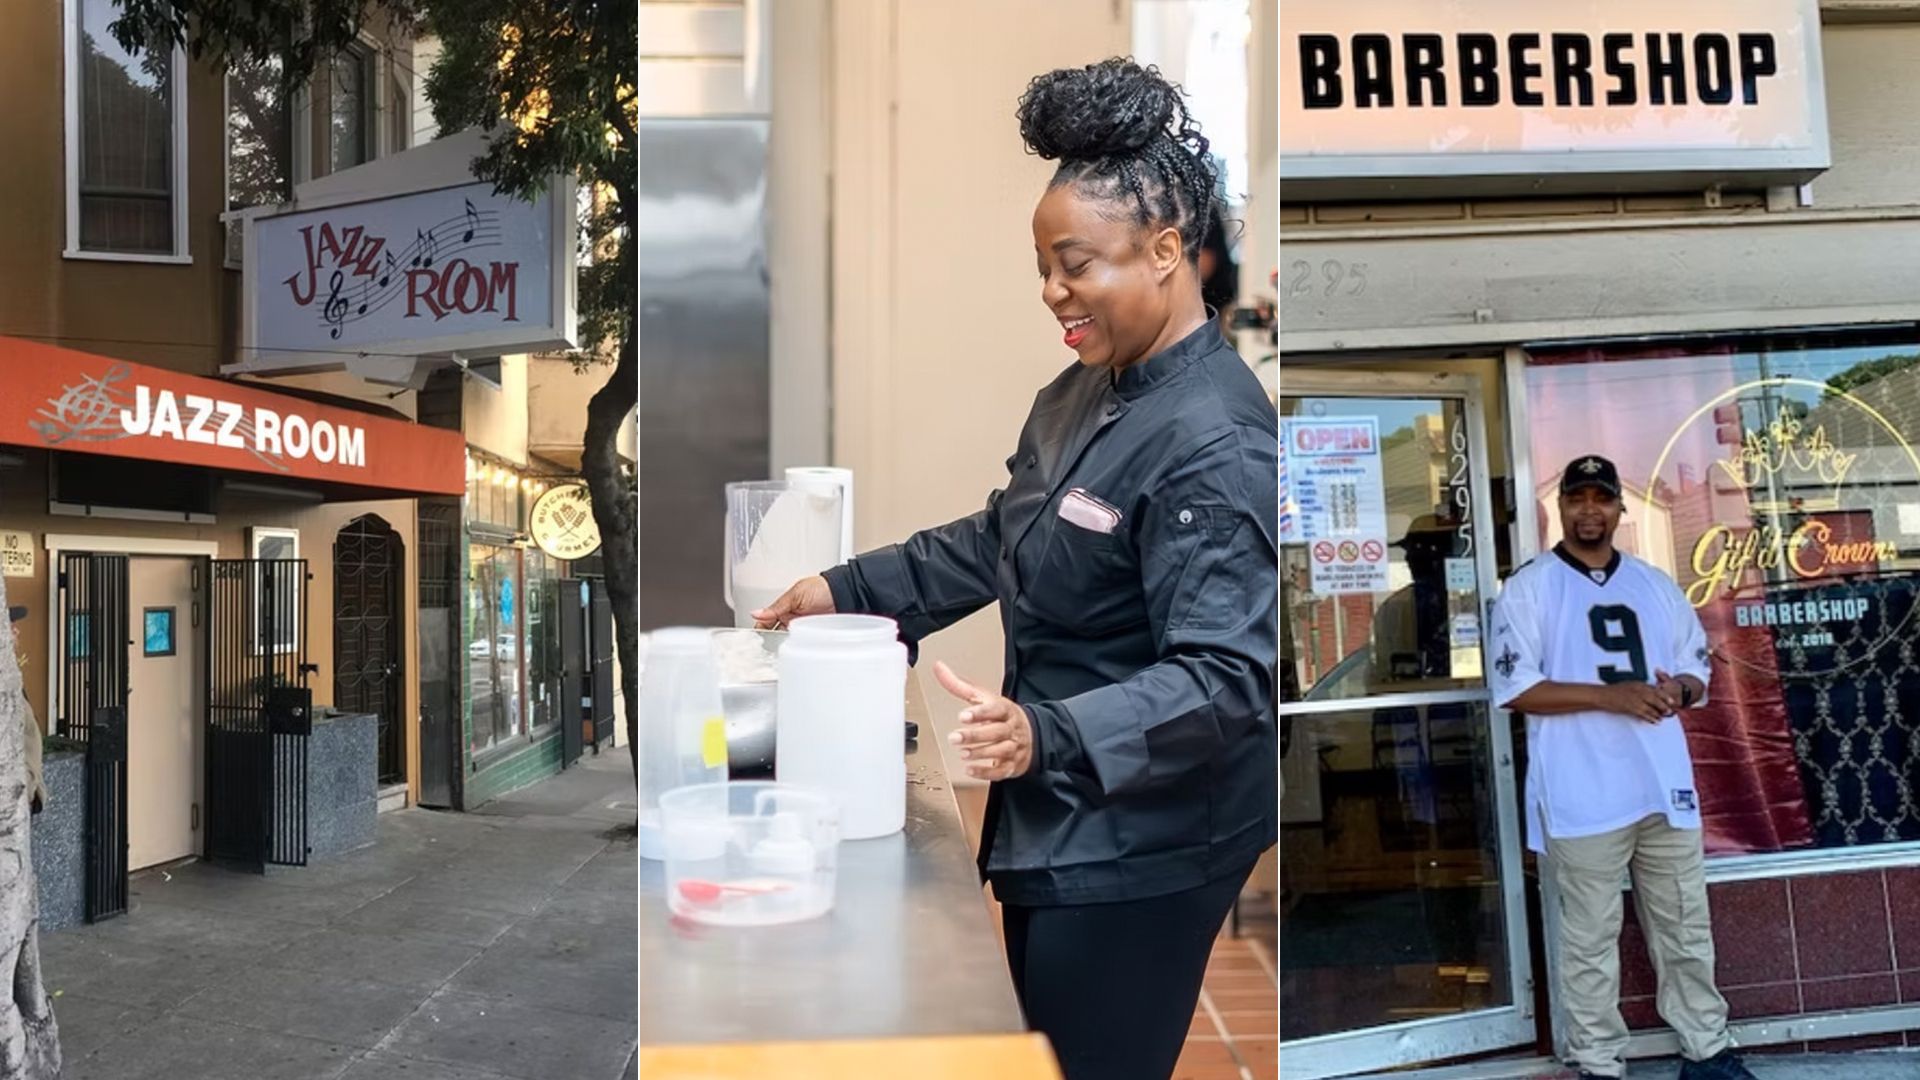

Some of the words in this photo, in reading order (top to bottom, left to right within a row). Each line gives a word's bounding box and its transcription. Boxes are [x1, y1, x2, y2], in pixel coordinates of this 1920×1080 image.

[1298, 32, 1777, 109] BARBERSHOP
[282, 221, 386, 307] JAZZ
[403, 258, 520, 322] ROOM
[120, 384, 245, 449] JAZZ
[255, 407, 366, 467] ROOM
[1296, 428, 1371, 452] OPEN
[1449, 418, 1475, 559] 6295
[5, 534, 18, 549] NO
[1788, 519, 1898, 577] Crowns
[1588, 604, 1648, 685] 9
[1736, 598, 1869, 627] BARBERSHOP
